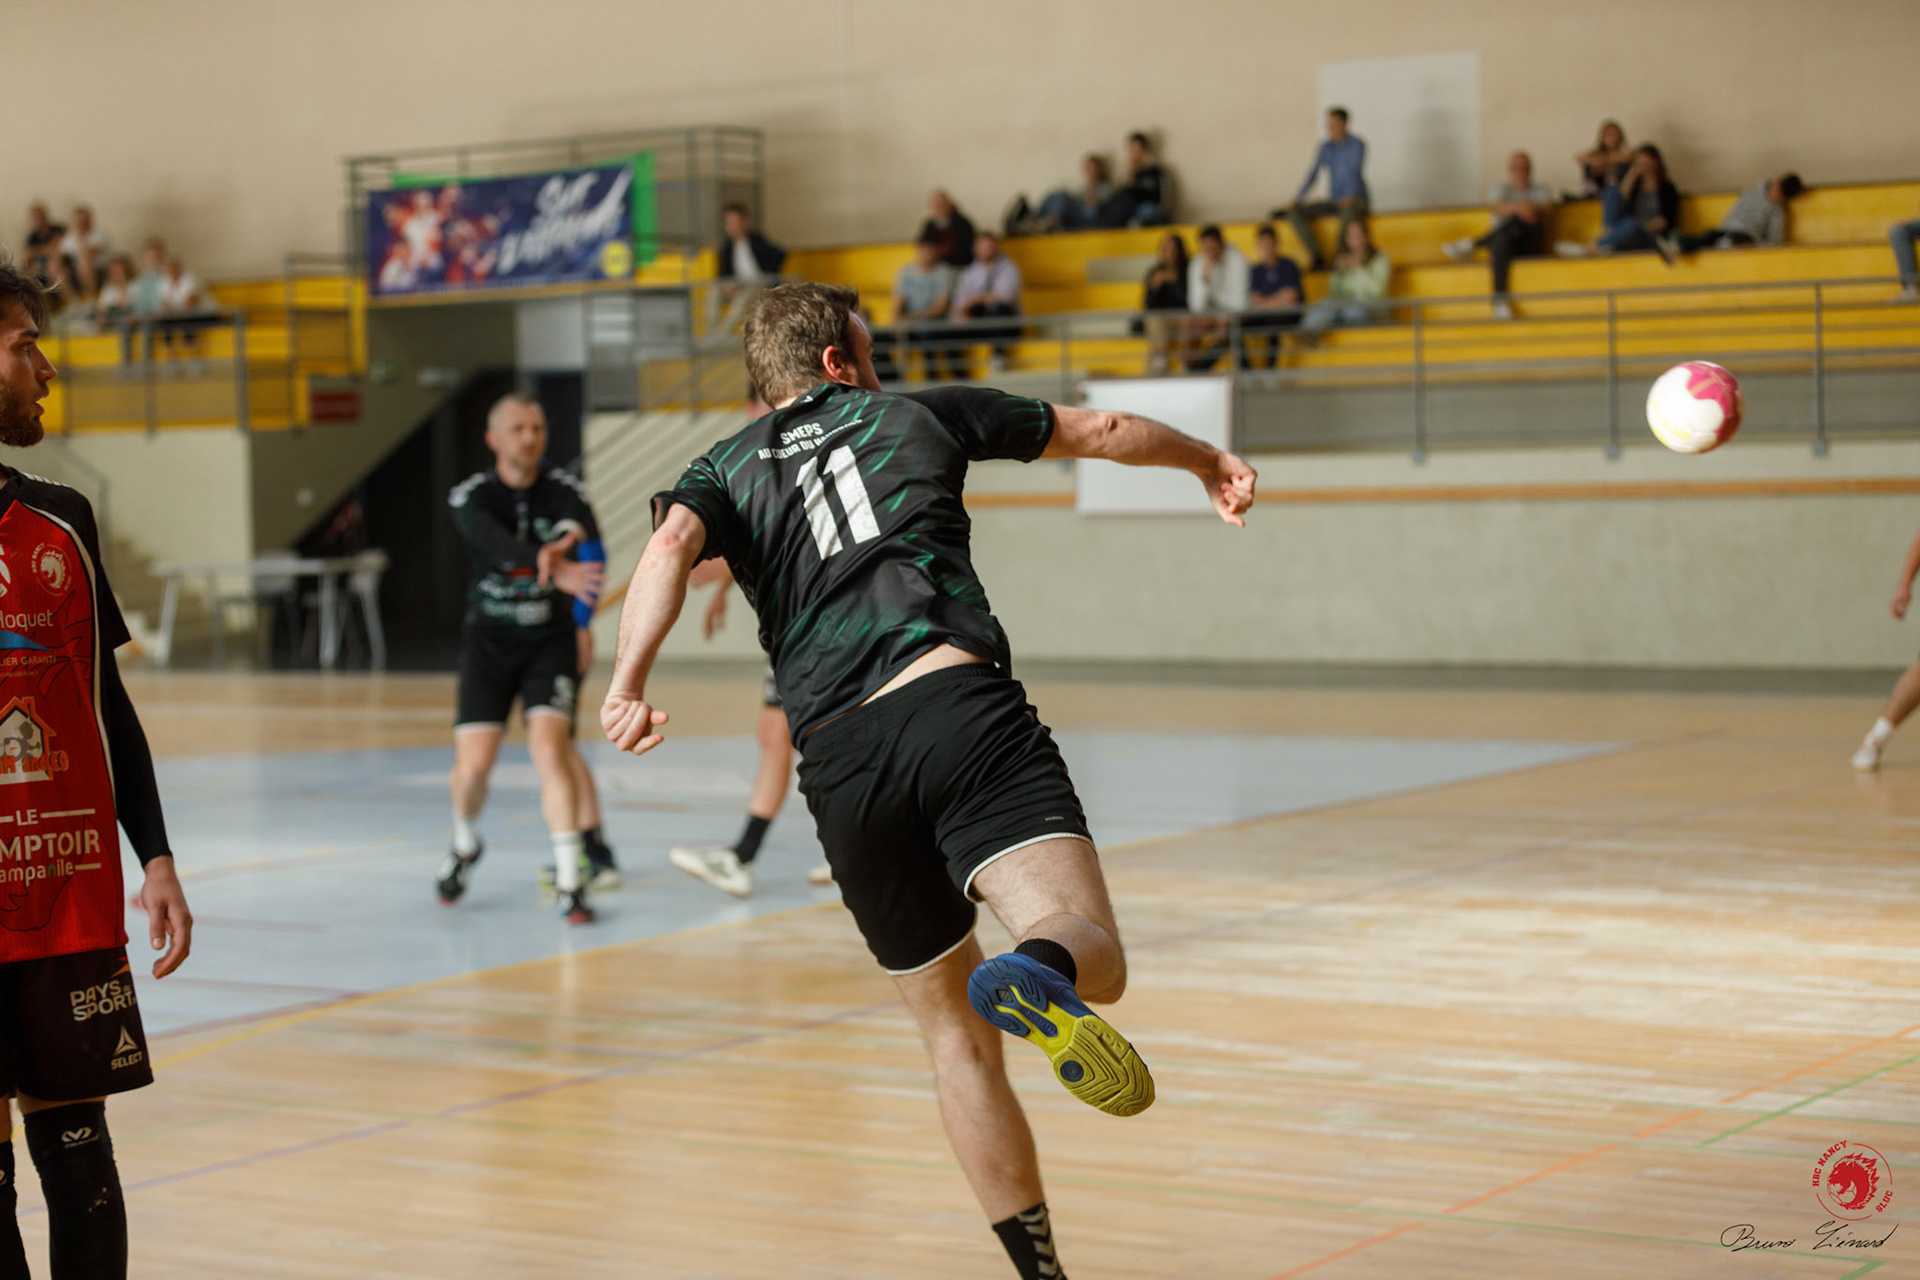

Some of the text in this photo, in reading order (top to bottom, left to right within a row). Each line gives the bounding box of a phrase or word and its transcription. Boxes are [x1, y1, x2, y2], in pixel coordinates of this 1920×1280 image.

[779, 422, 824, 445] SMEPS
[757, 450, 772, 461] AU
[801, 439, 814, 451] DU
[795, 445, 881, 561] 11
[21, 655, 57, 666] GARANTI
[16, 808, 39, 826] LE
[0, 829, 101, 863] MPTOIR
[69, 979, 122, 1007] PAYS
[110, 1050, 143, 1071] SELECT
